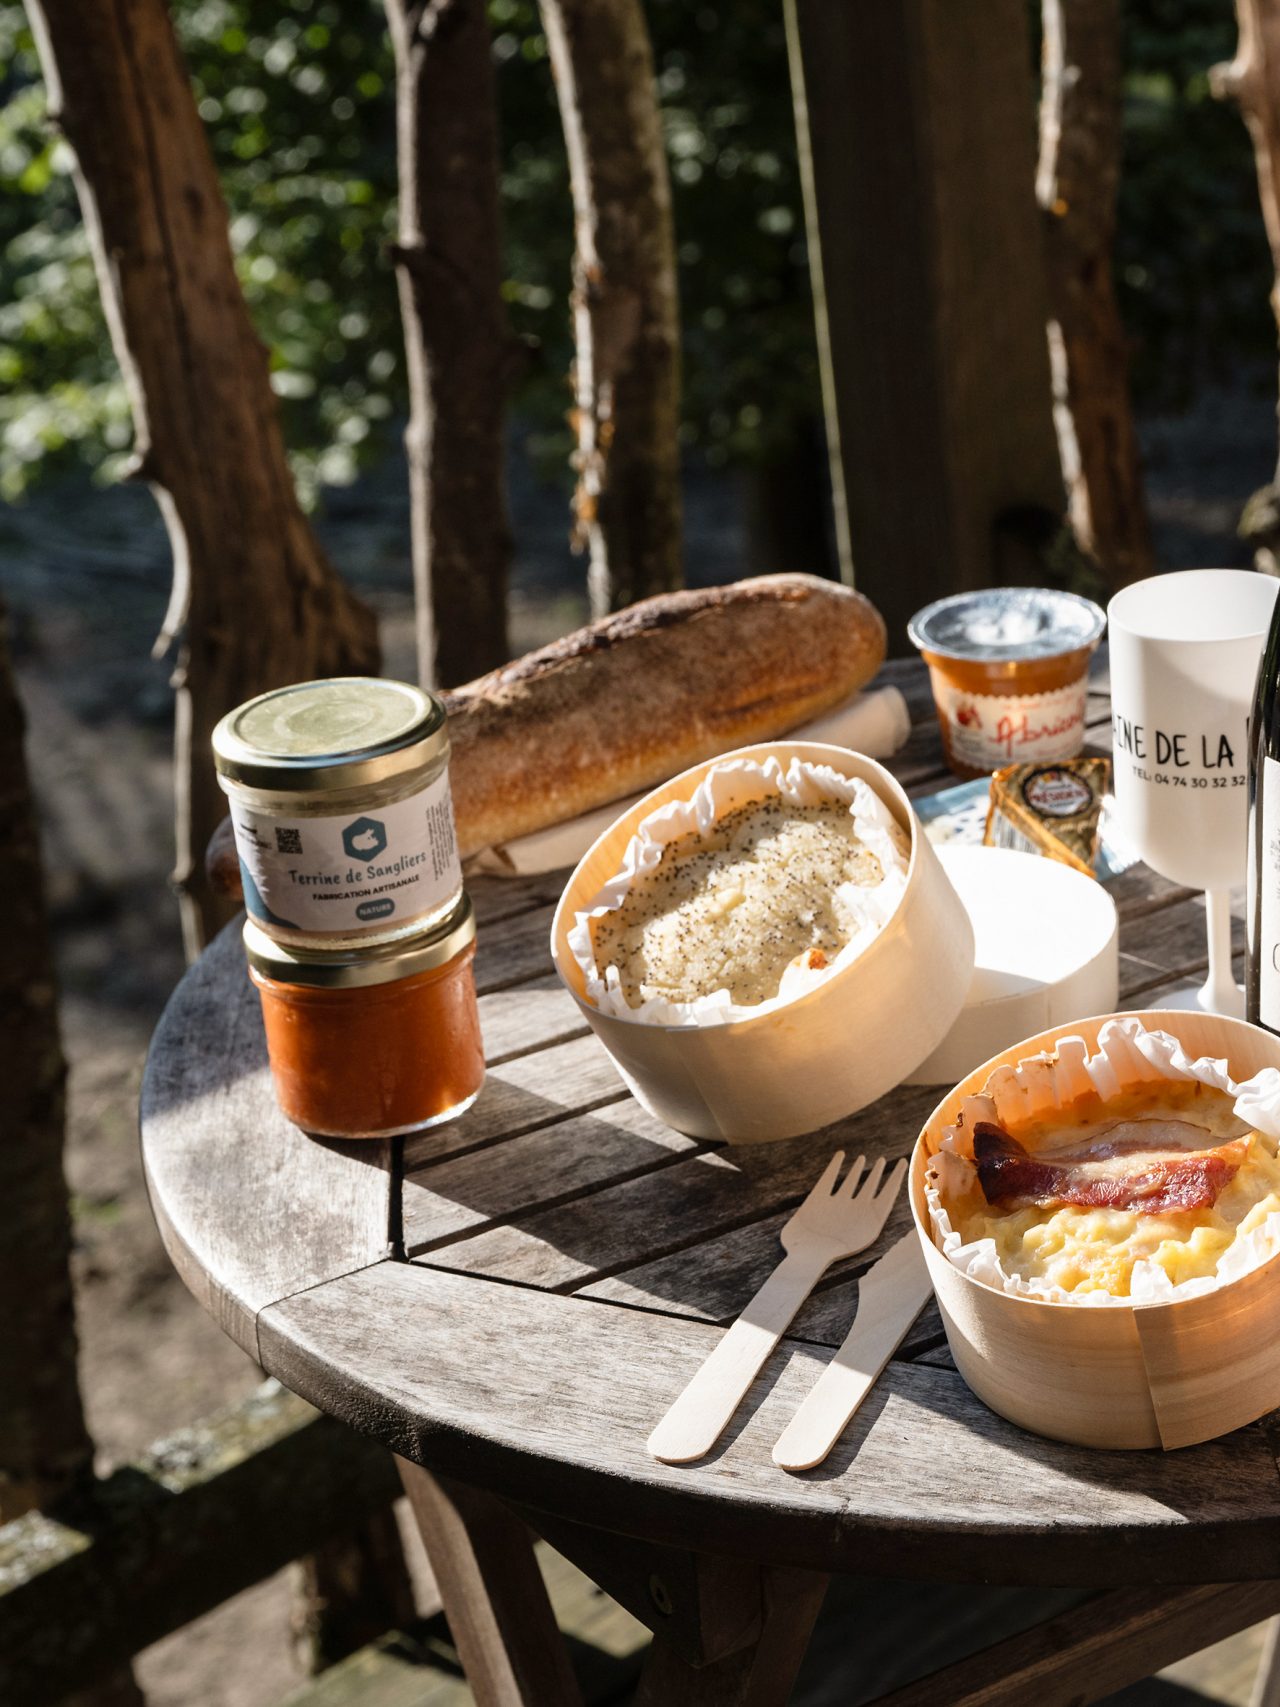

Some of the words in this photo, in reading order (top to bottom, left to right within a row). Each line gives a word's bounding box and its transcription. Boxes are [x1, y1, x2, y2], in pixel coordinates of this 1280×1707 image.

[1113, 715, 1147, 759] INE
[1155, 730, 1190, 768] DE
[1202, 734, 1234, 769] LA
[1154, 773, 1170, 785] 04
[1173, 776, 1187, 787] 74
[1191, 777, 1208, 789] 30
[1212, 777, 1227, 788] 32
[1231, 775, 1246, 786] 32
[288, 870, 340, 885] Terrine
[346, 868, 362, 883] de
[367, 852, 426, 880] Sangliers
[312, 888, 371, 901] FABRICATION
[373, 874, 420, 895] ARTISANALE
[359, 902, 392, 916] NATURE
